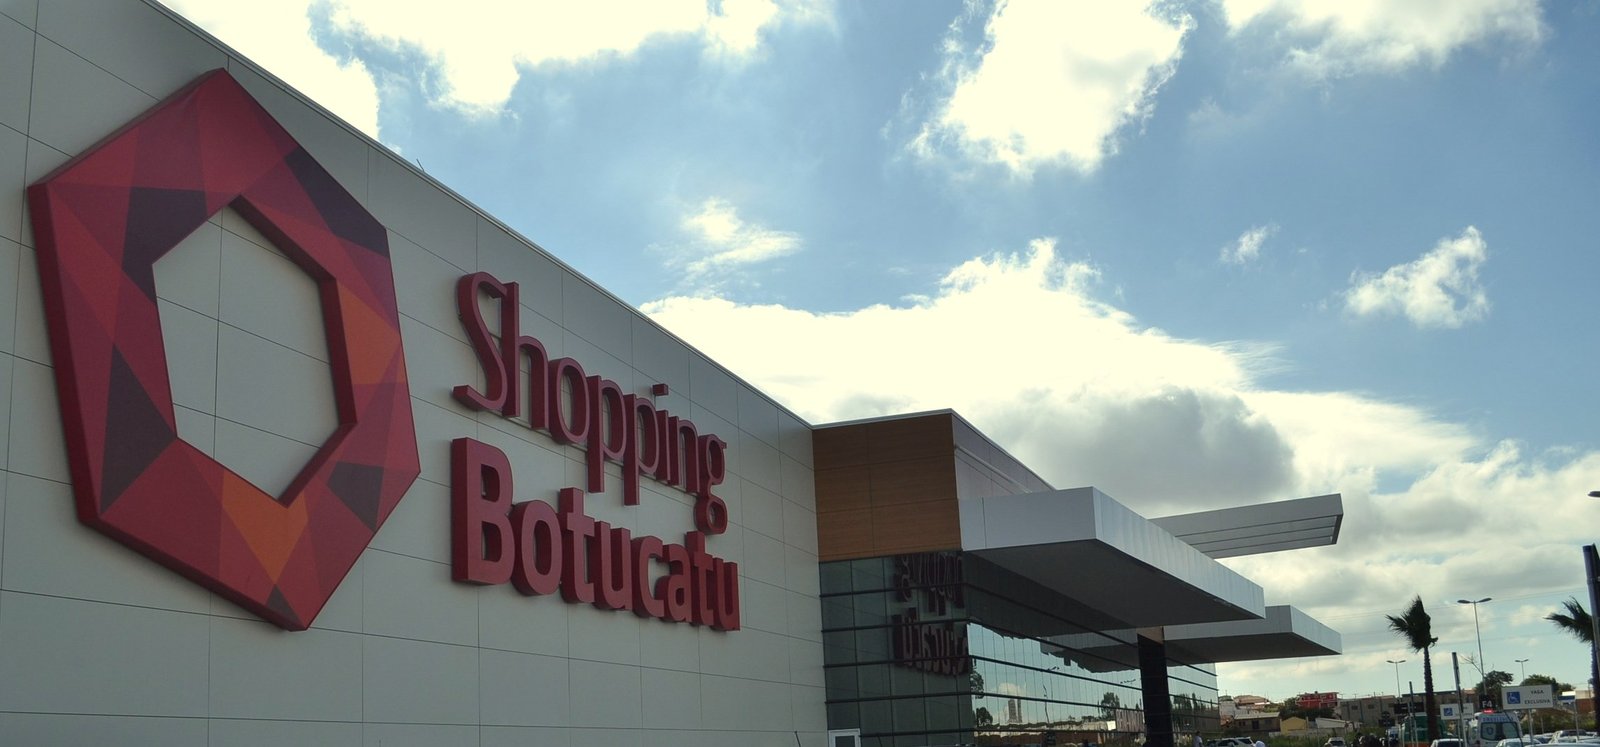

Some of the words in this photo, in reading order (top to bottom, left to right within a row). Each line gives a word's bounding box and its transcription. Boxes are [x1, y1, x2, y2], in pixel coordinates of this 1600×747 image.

[453, 271, 727, 534] Shopping
[451, 437, 740, 631] Botucatu
[1482, 700, 1493, 708] F4
